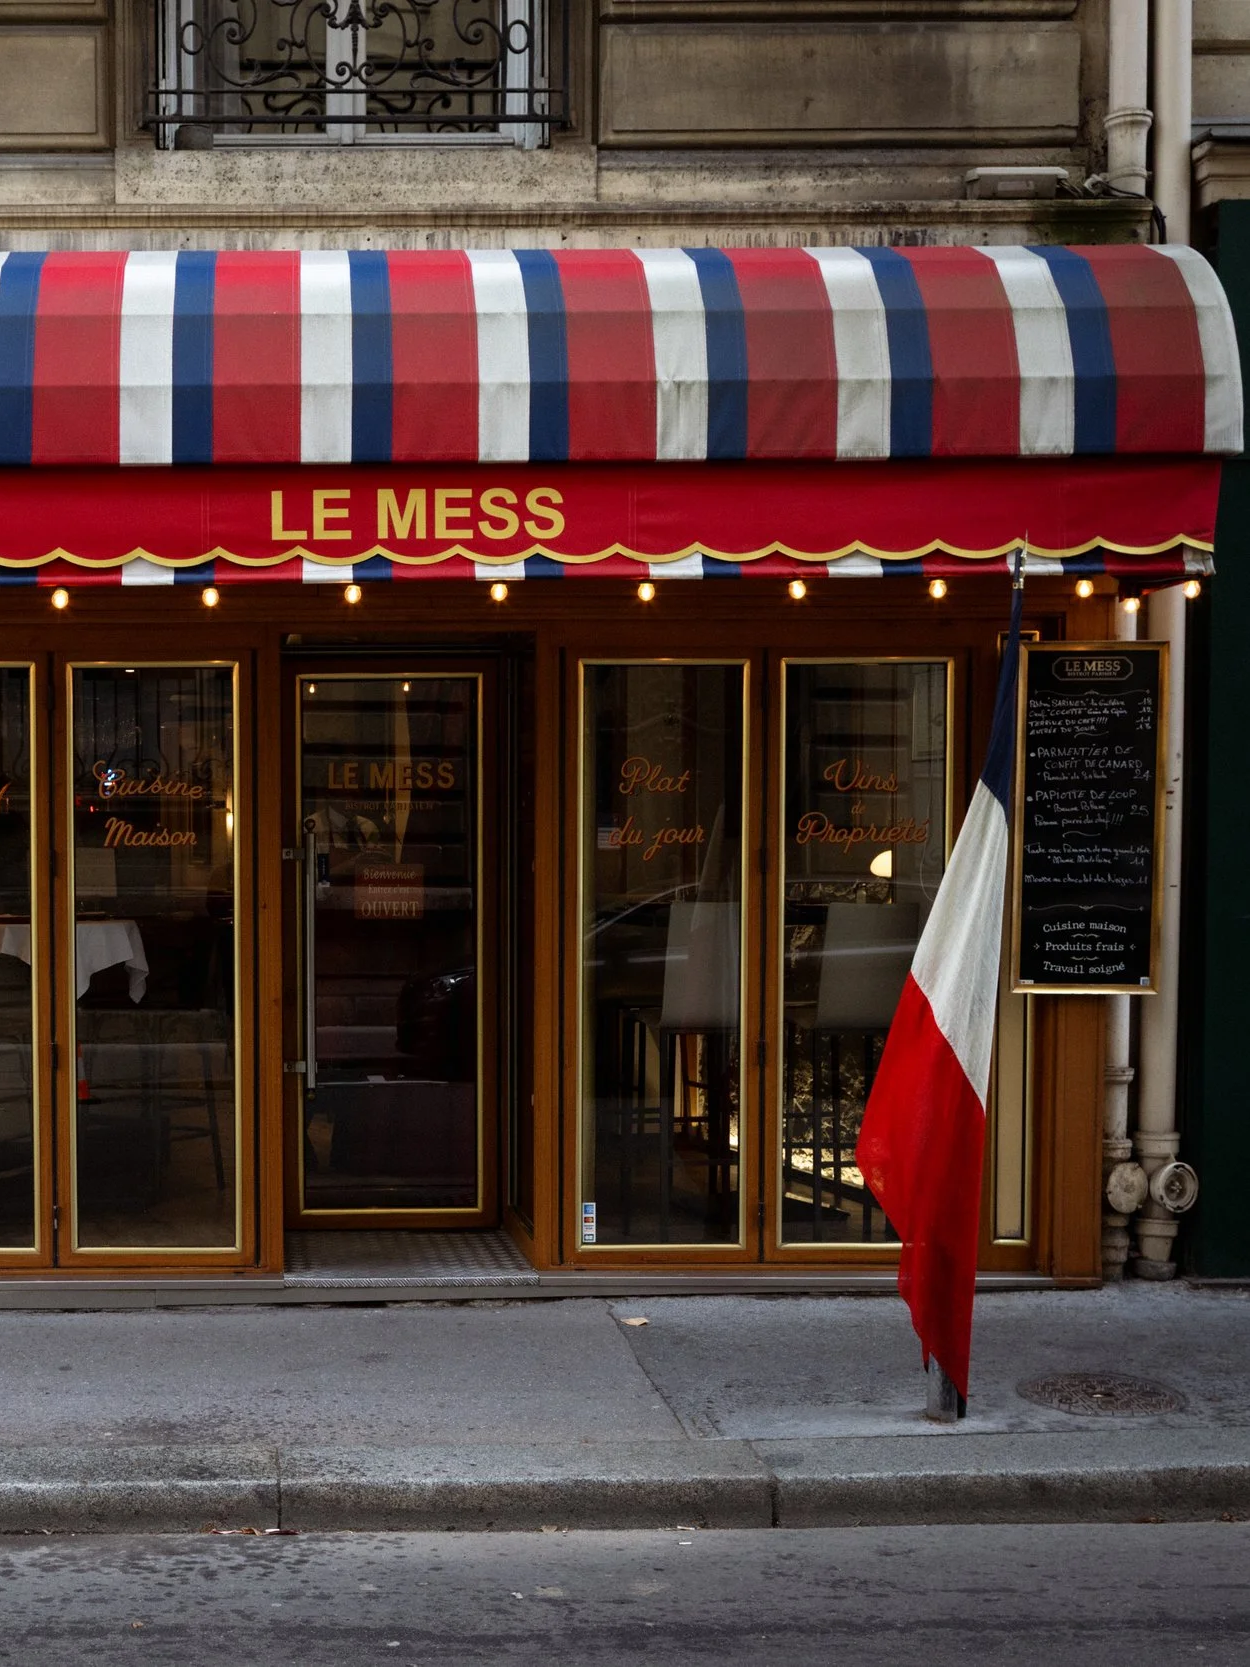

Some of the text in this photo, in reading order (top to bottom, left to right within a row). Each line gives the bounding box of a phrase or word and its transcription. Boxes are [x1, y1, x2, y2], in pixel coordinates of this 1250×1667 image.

[271, 487, 566, 540] LE MESS
[1065, 660, 1121, 672] LE MESS
[1037, 744, 1134, 758] PARMENTIER DE
[1044, 758, 1142, 769] CONFIT DE CANARD
[92, 760, 204, 799] Cuisine
[327, 761, 455, 790] LE MESS
[619, 756, 690, 794] Plat
[824, 759, 899, 793] Vins
[1133, 769, 1152, 781] 24
[1090, 790, 1107, 800] DE
[1109, 788, 1137, 799] LOUP
[851, 800, 866, 815] de
[1130, 804, 1150, 816] 25
[104, 817, 197, 848] Maison
[608, 816, 705, 861] du jour
[796, 811, 929, 853] Propriété
[363, 867, 417, 880] Bienvenue
[361, 901, 419, 917] OUVERT
[1042, 920, 1127, 933] Cuisine maison
[1045, 942, 1125, 952] Produits frais
[1042, 960, 1126, 975] Travail soigné
